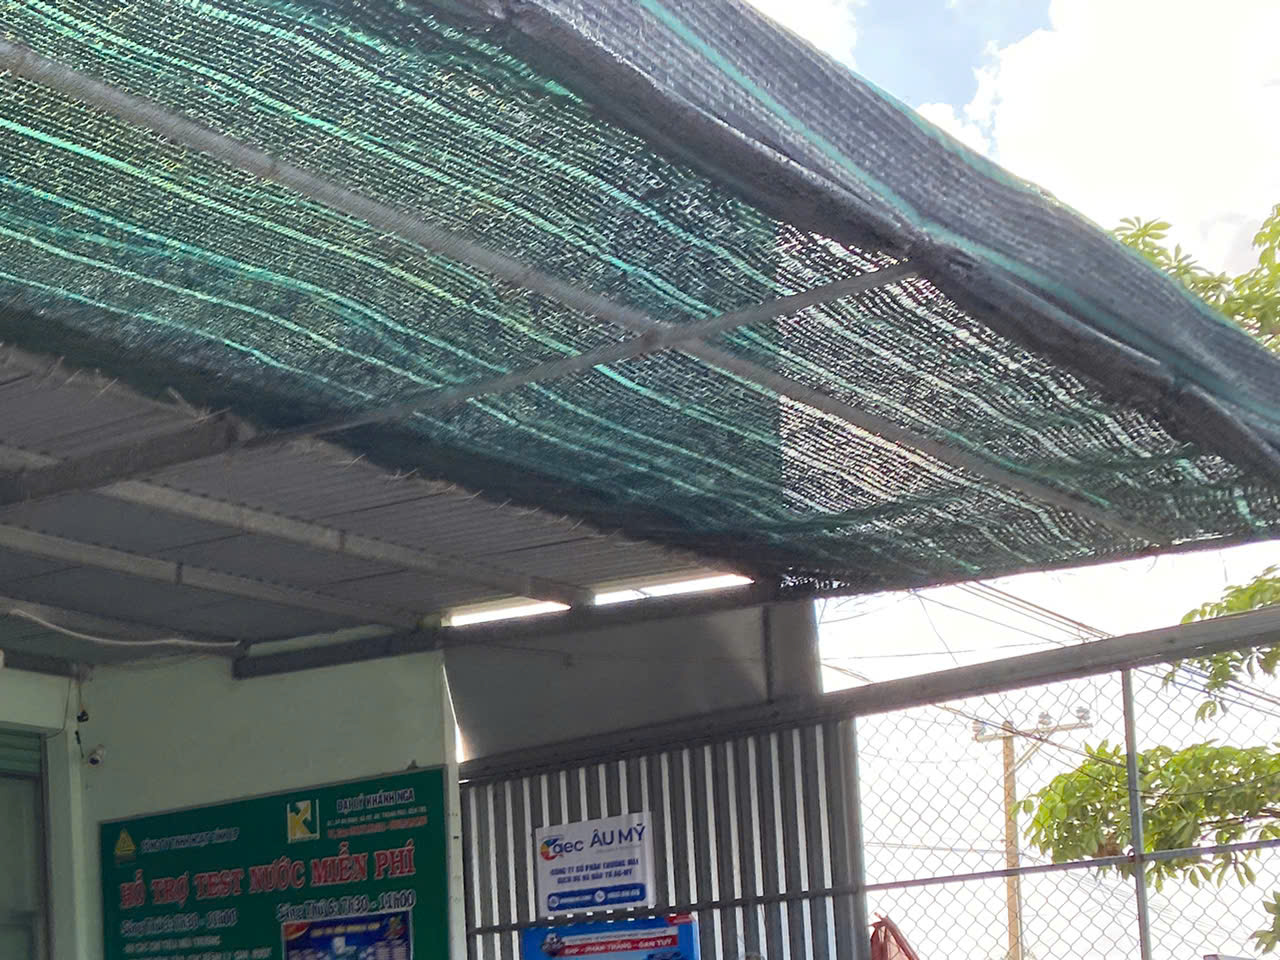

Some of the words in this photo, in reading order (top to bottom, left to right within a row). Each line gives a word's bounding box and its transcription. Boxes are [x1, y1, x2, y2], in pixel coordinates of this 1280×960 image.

[589, 828, 615, 849] ÂU
[617, 823, 646, 845] MỸ
[193, 867, 246, 901] TEST
[248, 855, 306, 894] NƯỚC
[310, 841, 369, 887] MIỄN
[374, 838, 417, 881] PHÍ
